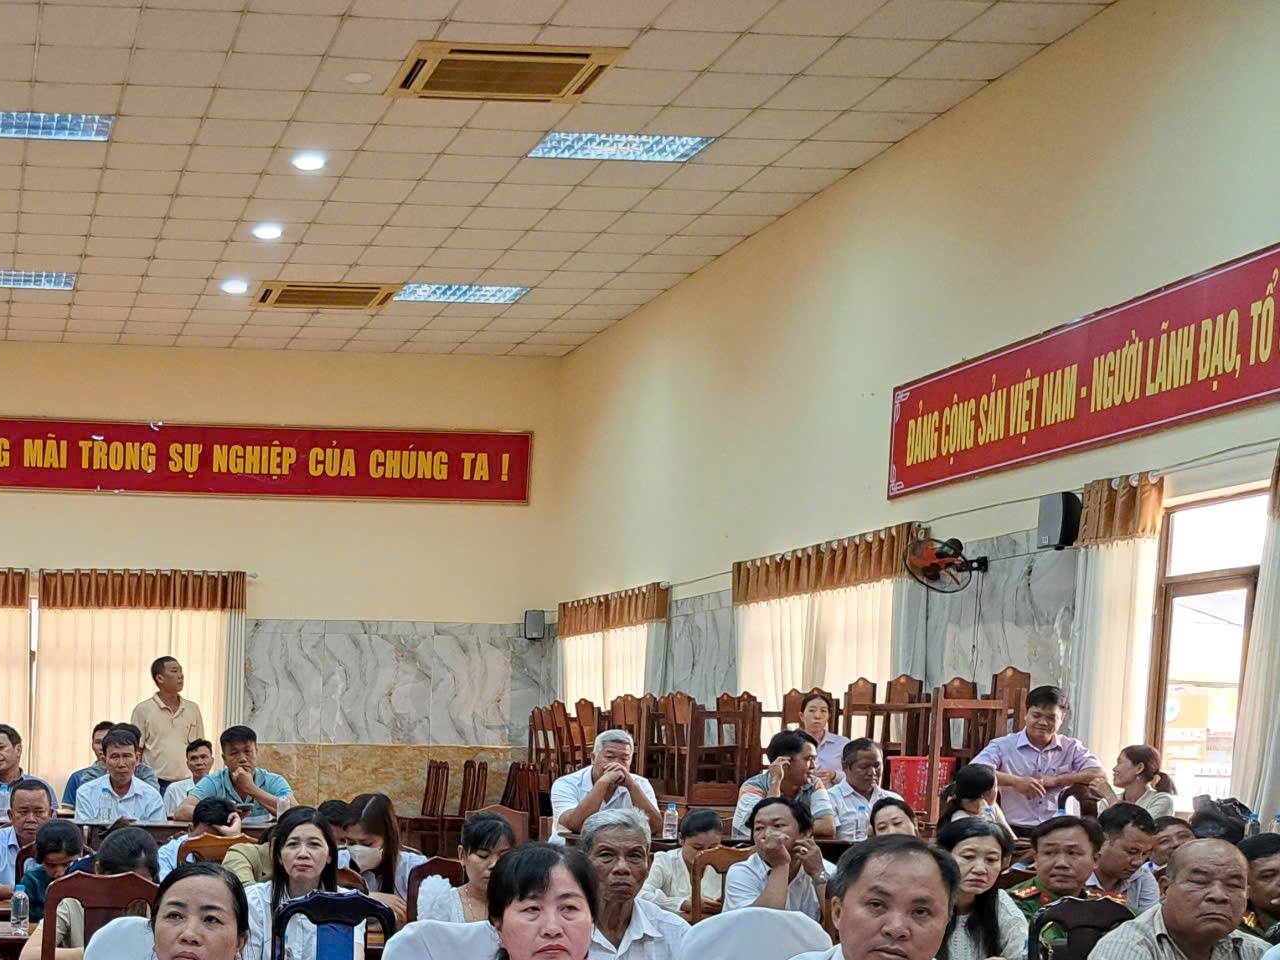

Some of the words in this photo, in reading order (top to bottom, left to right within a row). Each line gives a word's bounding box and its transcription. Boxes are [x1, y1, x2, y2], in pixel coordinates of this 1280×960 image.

[906, 400, 939, 467] ĐẢNG
[941, 393, 976, 465] CỘNG
[978, 374, 1007, 446] SẢN
[1009, 368, 1040, 445] VIỆT
[1041, 364, 1078, 427] NAM
[1080, 386, 1087, 398] -
[1090, 328, 1143, 412] NGƯỜI
[1145, 321, 1196, 396] LÃNH
[1198, 308, 1241, 392] ĐẠO,
[1249, 268, 1279, 365] TỔ
[23, 434, 67, 468] MÃI
[78, 440, 157, 472] TRONG
[168, 443, 201, 477] SỰ
[213, 441, 297, 478] NGHIỆP
[309, 440, 356, 477] CỦA
[369, 444, 449, 481] CHÚNG
[461, 452, 489, 481] TA
[501, 454, 509, 482] !
